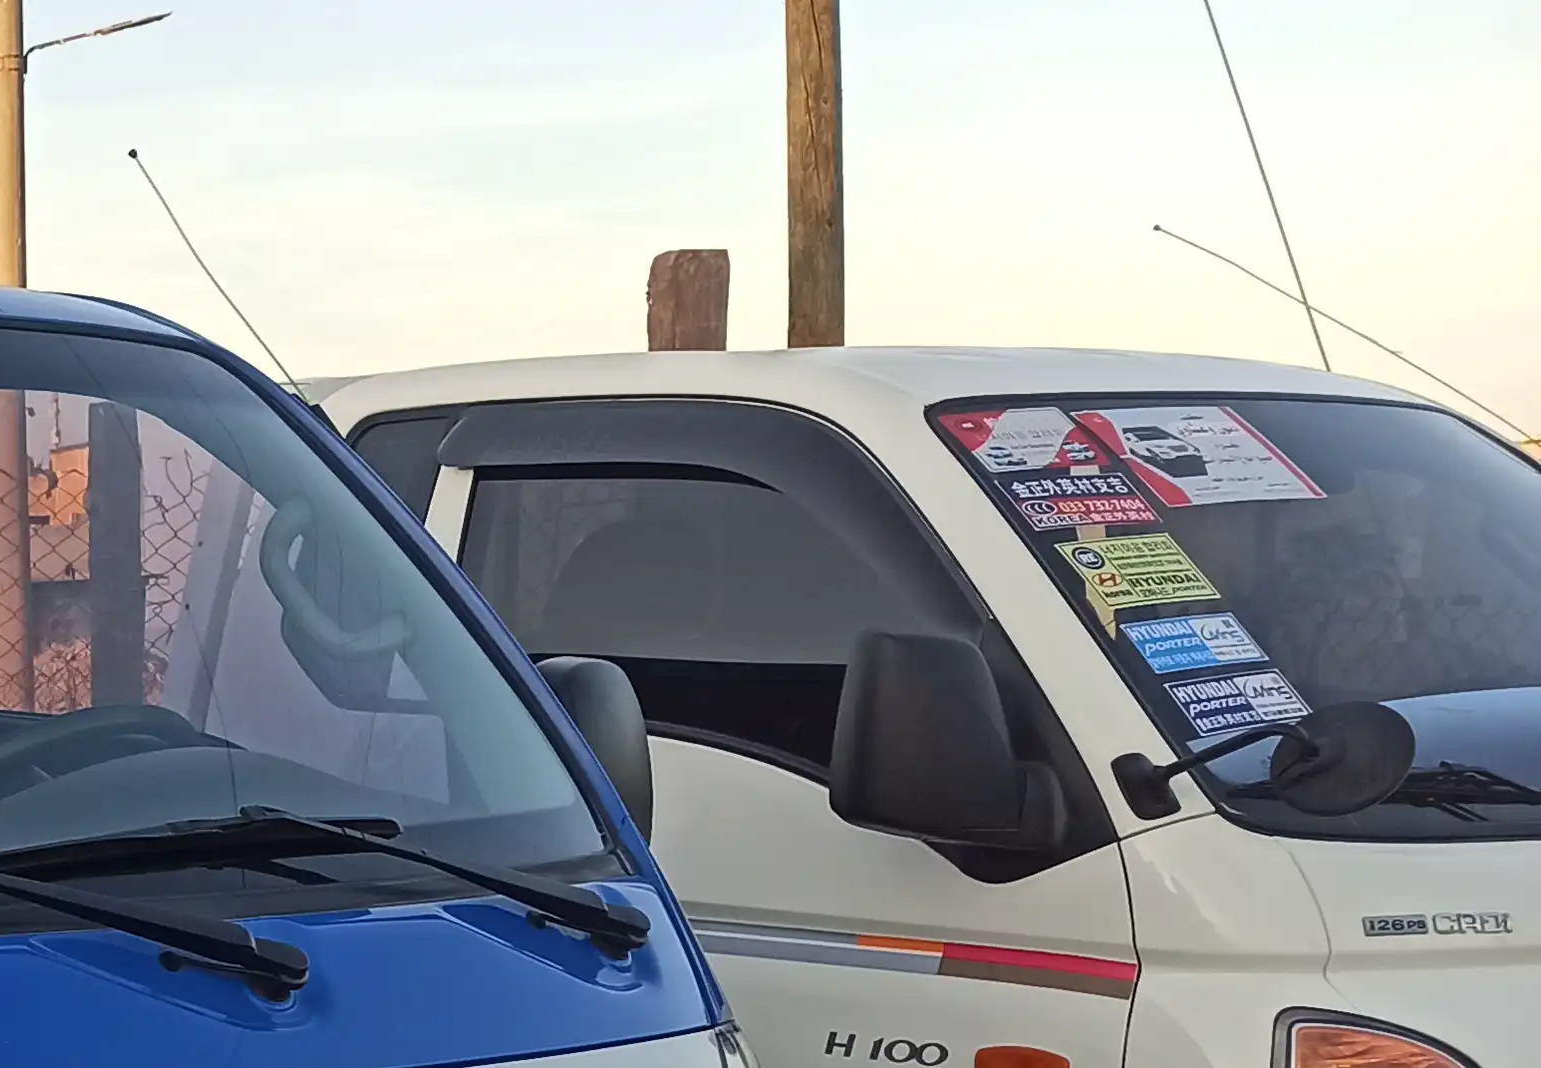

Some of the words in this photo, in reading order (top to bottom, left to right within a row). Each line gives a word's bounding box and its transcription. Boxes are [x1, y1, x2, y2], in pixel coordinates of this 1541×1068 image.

[1058, 501, 1086, 512] 033
[1034, 514, 1089, 526] KOREA
[1128, 573, 1201, 588] HYUNDAI
[1126, 620, 1193, 640] HYUNDAI
[1172, 680, 1239, 703] HYUNDAI
[824, 1031, 856, 1057] H
[869, 1037, 948, 1066] 100
